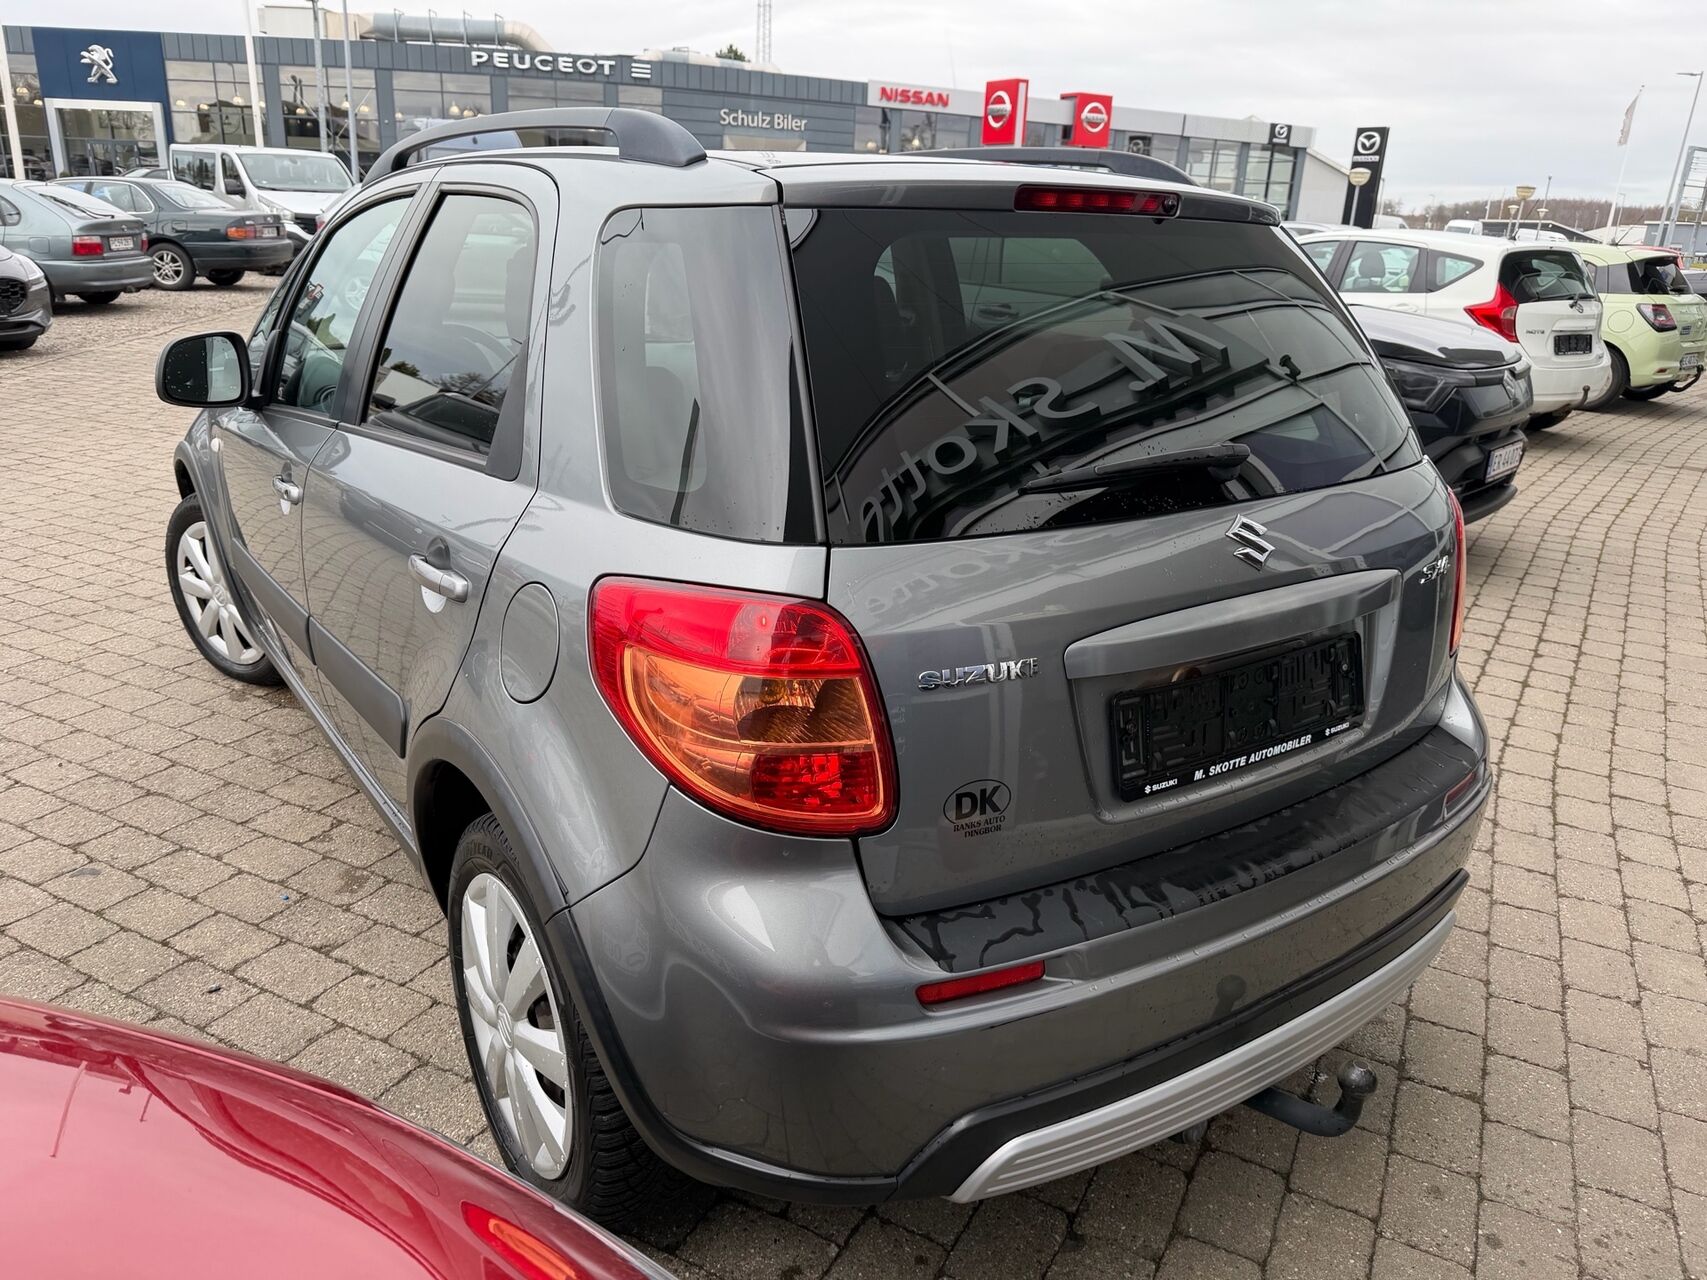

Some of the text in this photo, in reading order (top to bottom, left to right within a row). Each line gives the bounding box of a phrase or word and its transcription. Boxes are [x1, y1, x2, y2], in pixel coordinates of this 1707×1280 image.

[471, 51, 615, 76] PEUGEOT
[879, 87, 949, 108] NISSAN
[720, 109, 807, 131] Schulz Biler
[918, 658, 1038, 690] SUZUKI
[1194, 734, 1312, 781] M. SKOTTE AUTOMOBILER
[1152, 778, 1178, 791] SUZUKI
[955, 785, 1001, 820] DK
[983, 815, 1006, 827] AUTO
